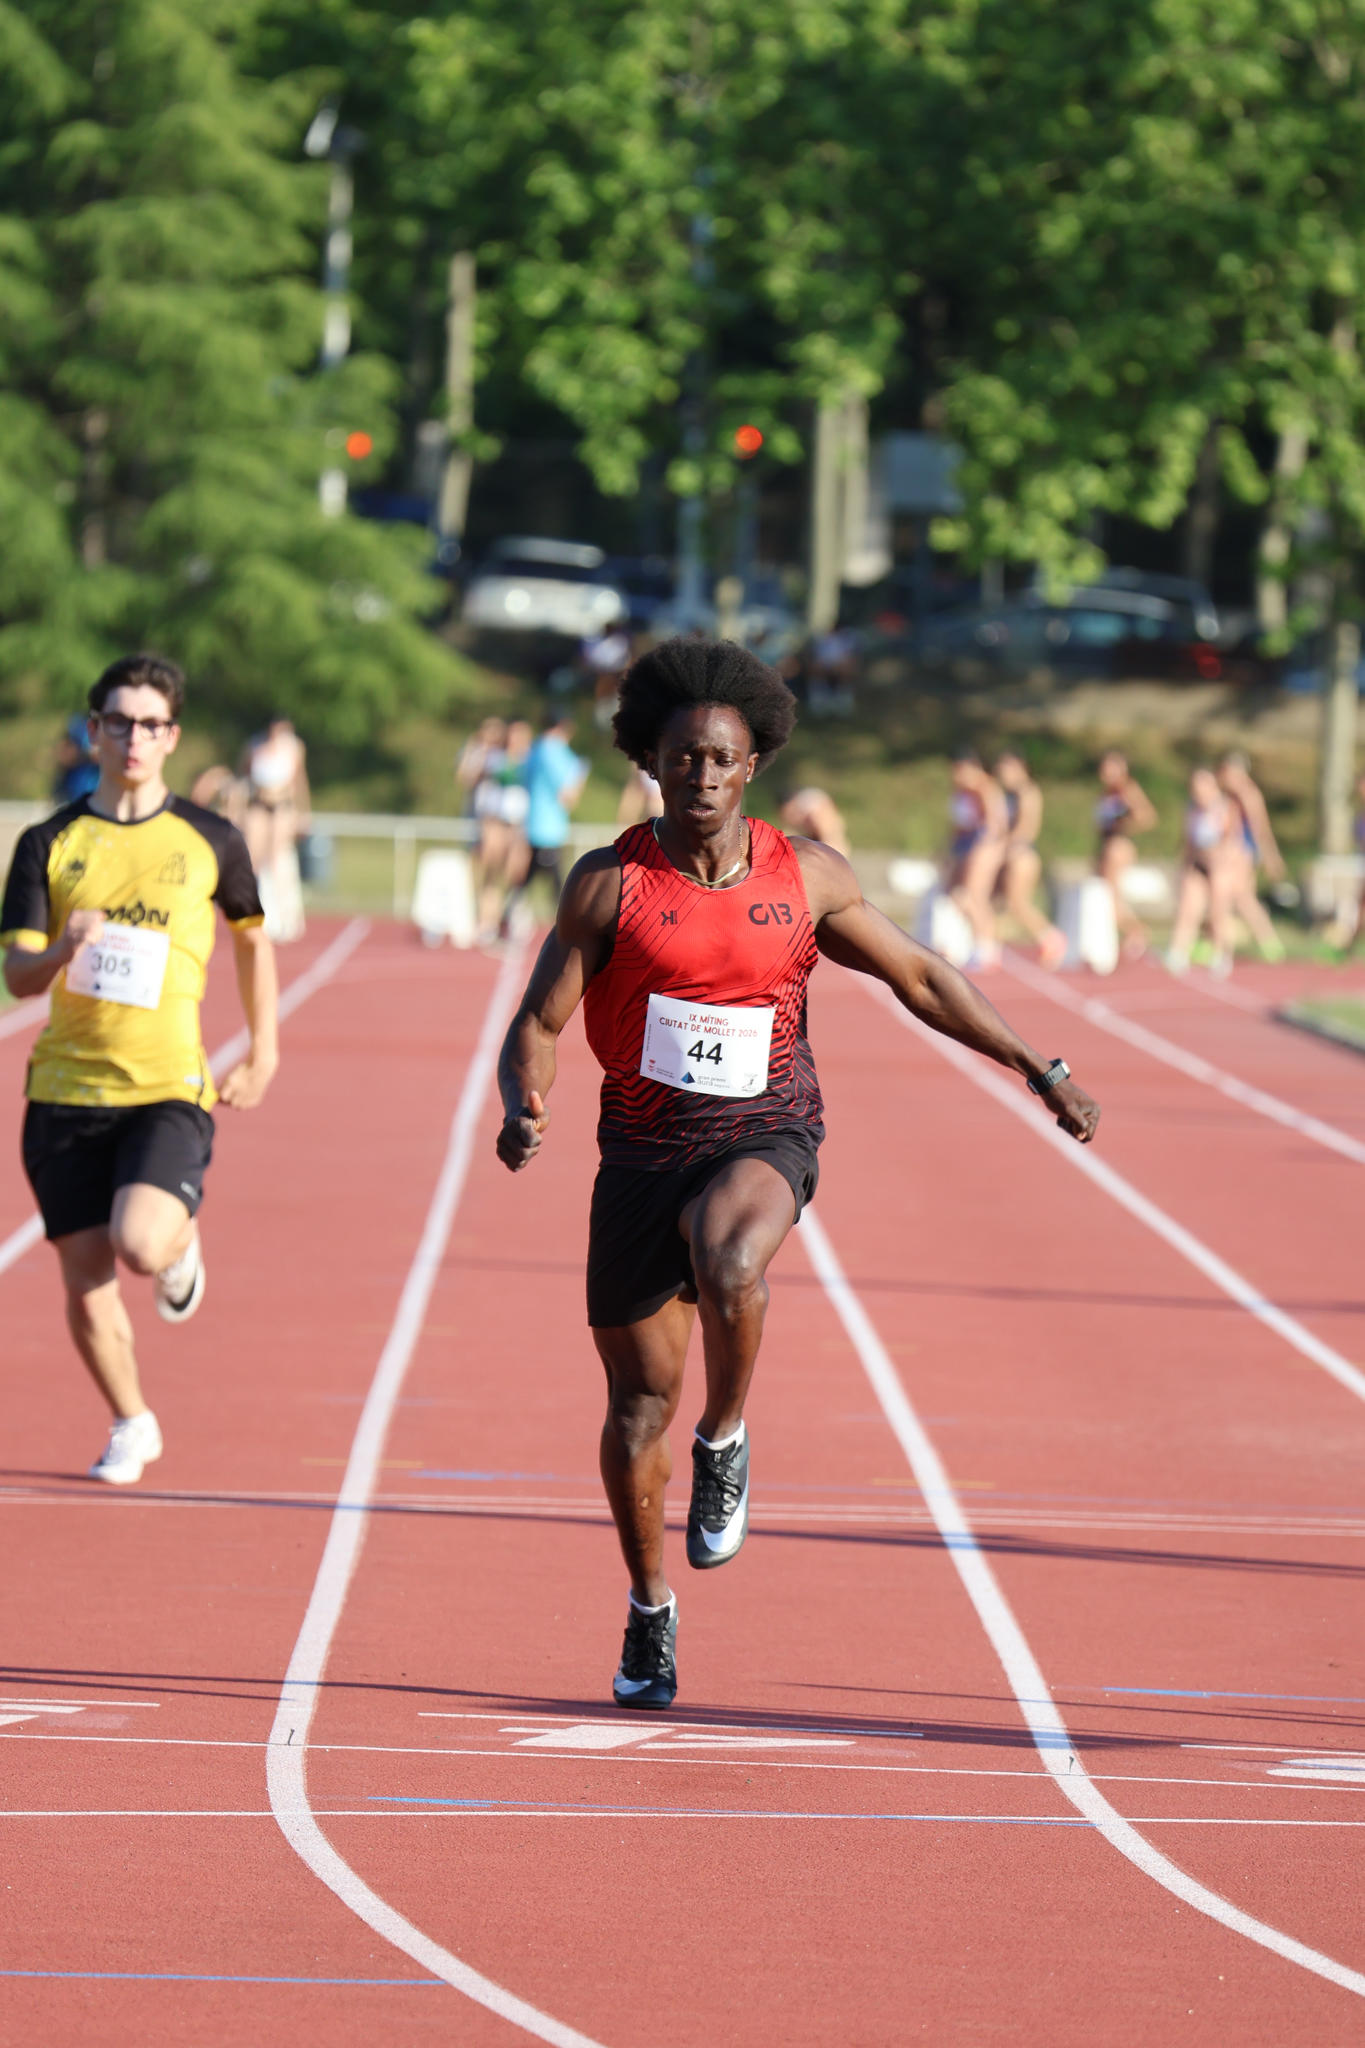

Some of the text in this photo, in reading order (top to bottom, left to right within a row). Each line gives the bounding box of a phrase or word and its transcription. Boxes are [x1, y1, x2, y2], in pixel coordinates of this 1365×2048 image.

[91, 951, 132, 976] 305
[659, 1017, 688, 1030] CIUTAT
[703, 1025, 735, 1037] MOLLET
[689, 1013, 697, 1021] IX
[687, 1040, 723, 1065] 44
